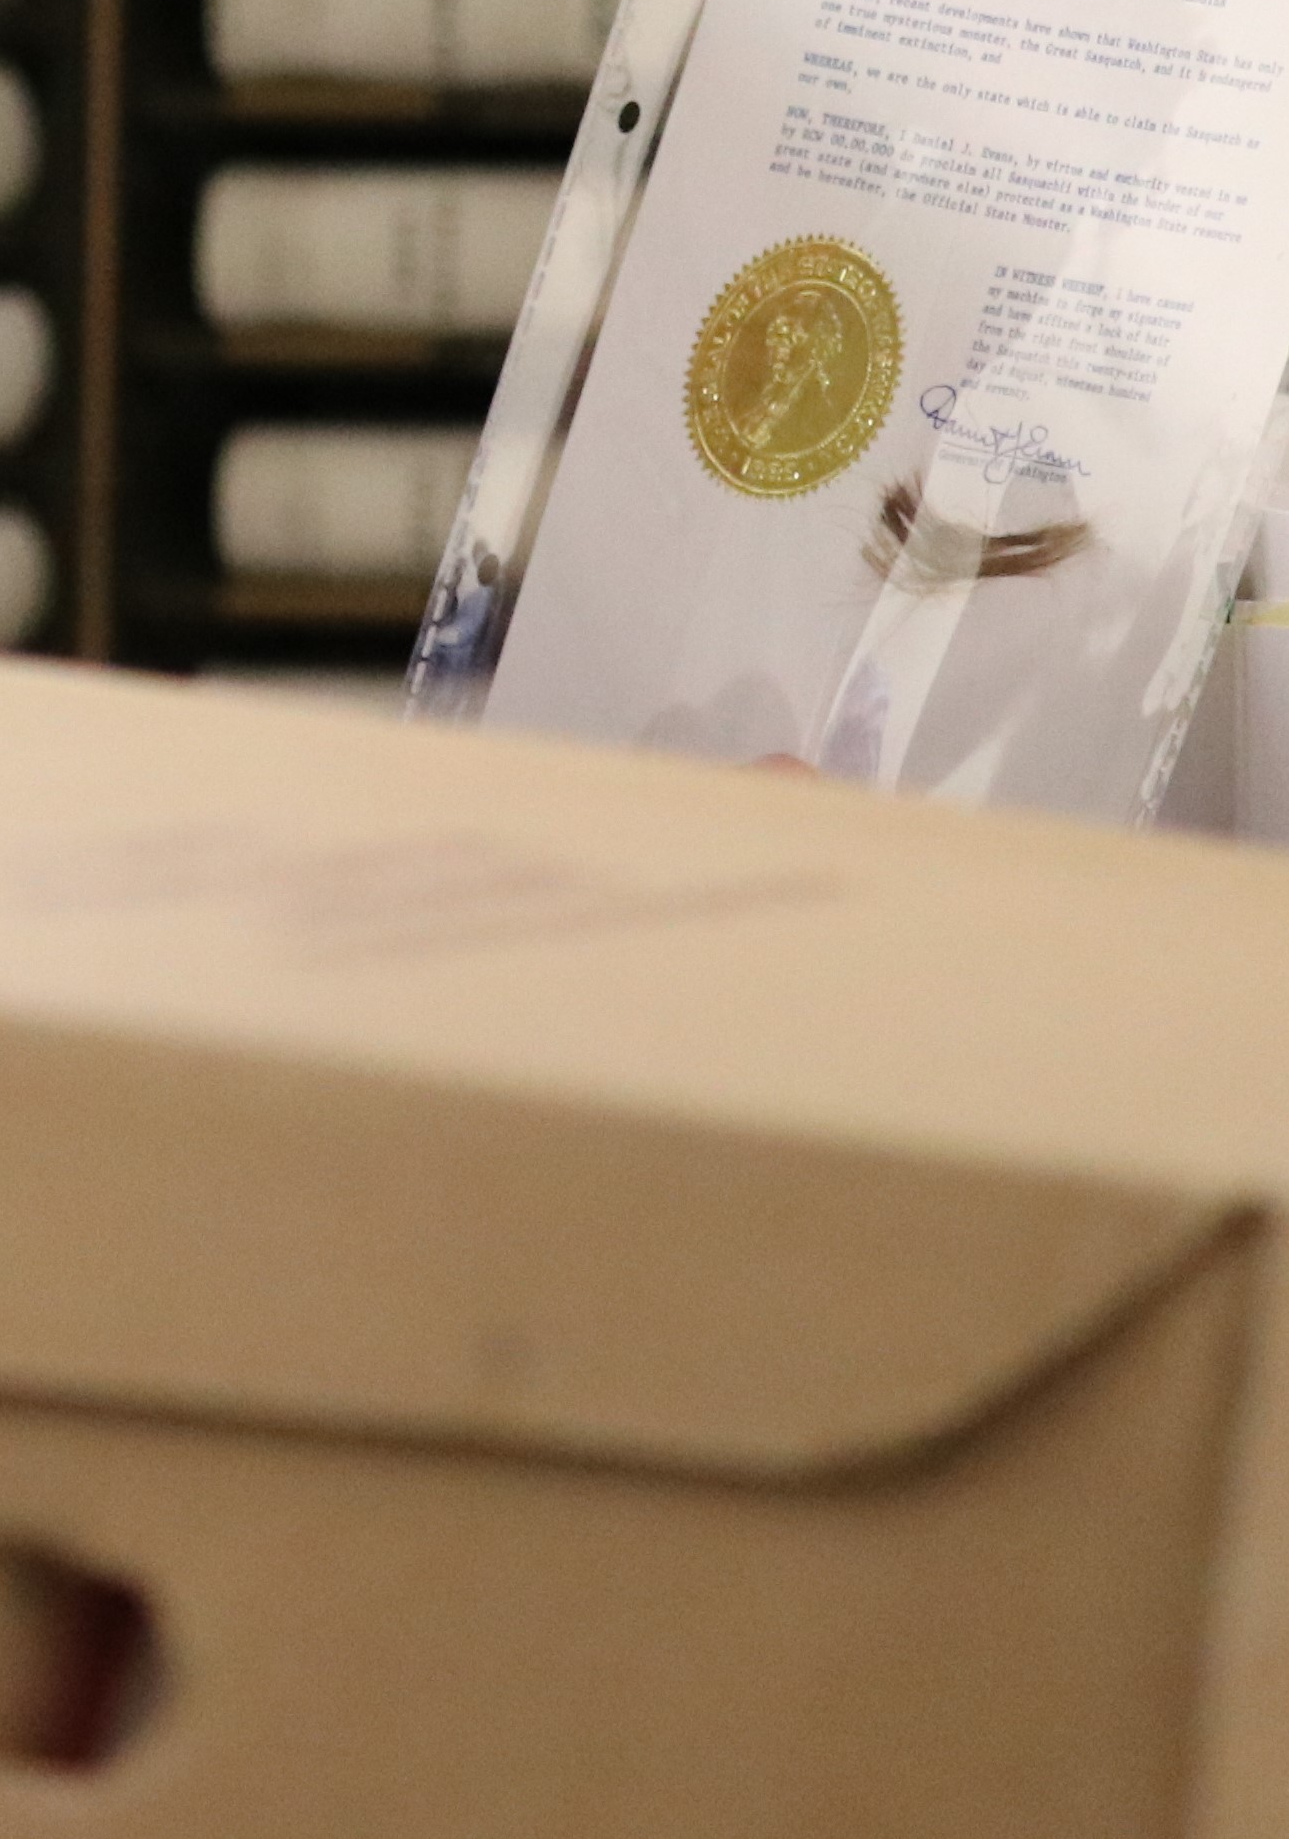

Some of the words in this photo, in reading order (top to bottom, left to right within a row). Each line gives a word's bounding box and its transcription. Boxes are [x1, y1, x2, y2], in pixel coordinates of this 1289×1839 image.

[814, 18, 831, 29] of
[837, 21, 892, 42] imminent
[899, 36, 972, 60] extinction,
[981, 52, 1003, 63] and
[820, 2, 842, 13] one
[849, 6, 877, 20] true
[883, 14, 953, 34] mysterious
[959, 29, 1011, 49] monster,
[1020, 38, 1040, 51] the
[1046, 42, 1079, 58] Great
[1085, 49, 1145, 73] Sasquatch,
[1154, 64, 1174, 75] and
[1180, 67, 1192, 79] it
[1210, 74, 1272, 92] endangered
[938, 3, 1019, 28] developments
[1025, 19, 1051, 34] have
[1058, 27, 1091, 41] shown
[1096, 33, 1122, 47] that
[1127, 38, 1191, 59] Washington
[1197, 50, 1228, 65] State
[1233, 56, 1252, 70] has
[1258, 63, 1284, 78] only
[797, 74, 818, 85] our
[826, 79, 851, 94] own,
[802, 53, 857, 76] WHEREAS,
[866, 68, 880, 78] we
[887, 72, 908, 84] are
[916, 77, 936, 89] the
[942, 84, 971, 99] only
[977, 91, 1010, 105] state
[1017, 97, 1050, 112] which
[1056, 103, 1068, 115] is
[1075, 108, 1100, 121] able
[1106, 113, 1119, 124] to
[1125, 117, 1156, 131] claim
[1162, 123, 1180, 135] the
[1186, 127, 1242, 146] Sasquatch
[1247, 139, 1260, 149] as
[780, 124, 796, 139] by
[829, 134, 895, 157] 00.00.000
[900, 149, 915, 162] do
[920, 156, 977, 175] proclaim
[982, 168, 1002, 180] all
[1077, 186, 1115, 201] within
[1121, 194, 1139, 206] the
[1144, 197, 1181, 213] border
[1186, 205, 1200, 216] of
[1204, 210, 1224, 220] our
[786, 106, 811, 124] NOW,
[821, 113, 889, 140] THEREFORE,
[900, 130, 906, 140] I
[913, 132, 954, 151] Daniel
[961, 143, 971, 155] J.
[981, 147, 1018, 167] Evans,
[1026, 155, 1040, 170] by
[1046, 160, 1084, 176] virtue
[1089, 169, 1109, 180] and
[1115, 174, 1170, 194] authority
[1174, 185, 1212, 199] vested
[1217, 190, 1230, 202] in
[1235, 196, 1247, 205] me
[769, 162, 791, 174] and
[796, 165, 811, 178] be
[818, 170, 885, 197] hereafter,
[895, 188, 916, 201] the
[922, 192, 978, 213] Official
[984, 205, 1017, 221] State
[1022, 213, 1070, 232] Monster.
[773, 146, 810, 160] great
[817, 154, 852, 168] state
[858, 160, 888, 176] (and
[894, 170, 950, 189] anywhere
[956, 182, 991, 200] else)
[996, 191, 1055, 209] protected
[1060, 203, 1073, 212] as
[1078, 206, 1085, 215] a
[1090, 206, 1152, 227] Washington
[1157, 218, 1187, 233] State
[1193, 227, 1242, 243] resource
[988, 287, 1001, 299] my
[1007, 291, 1049, 305] machine
[1056, 298, 1068, 309] to
[1075, 300, 1104, 317] forge
[1109, 309, 1122, 321] my
[1128, 311, 1182, 330] signature
[995, 266, 1008, 278] IN
[1012, 269, 1056, 287] WITNESS
[1062, 278, 1107, 299] WHEREOF,
[1117, 288, 1123, 299] I
[1127, 290, 1152, 304] have
[1157, 298, 1195, 312] caused
[977, 321, 1003, 335] from
[1009, 327, 1025, 339] the
[1032, 332, 1062, 347] right
[1069, 338, 1099, 353] front
[1104, 345, 1151, 363] shoulder
[1156, 355, 1171, 366] of
[982, 305, 1003, 316] and
[1007, 307, 1032, 322] have
[1039, 314, 1081, 331] affixed
[1085, 325, 1091, 333] a
[1098, 324, 1122, 338] lock
[1126, 331, 1141, 342] of
[1145, 333, 1170, 347] hair
[966, 357, 986, 373] day
[991, 363, 1004, 374] of
[1011, 365, 1047, 385] August,
[1055, 375, 1103, 392] nineteen
[1109, 383, 1152, 401] hundred
[971, 340, 990, 353] the
[996, 344, 1051, 364] Sasquatch
[1056, 356, 1080, 369] this
[1086, 361, 1159, 383] twenty-sixth
[959, 378, 980, 389] and
[985, 383, 1030, 401] seventy.
[1008, 462, 1067, 483] ashington
